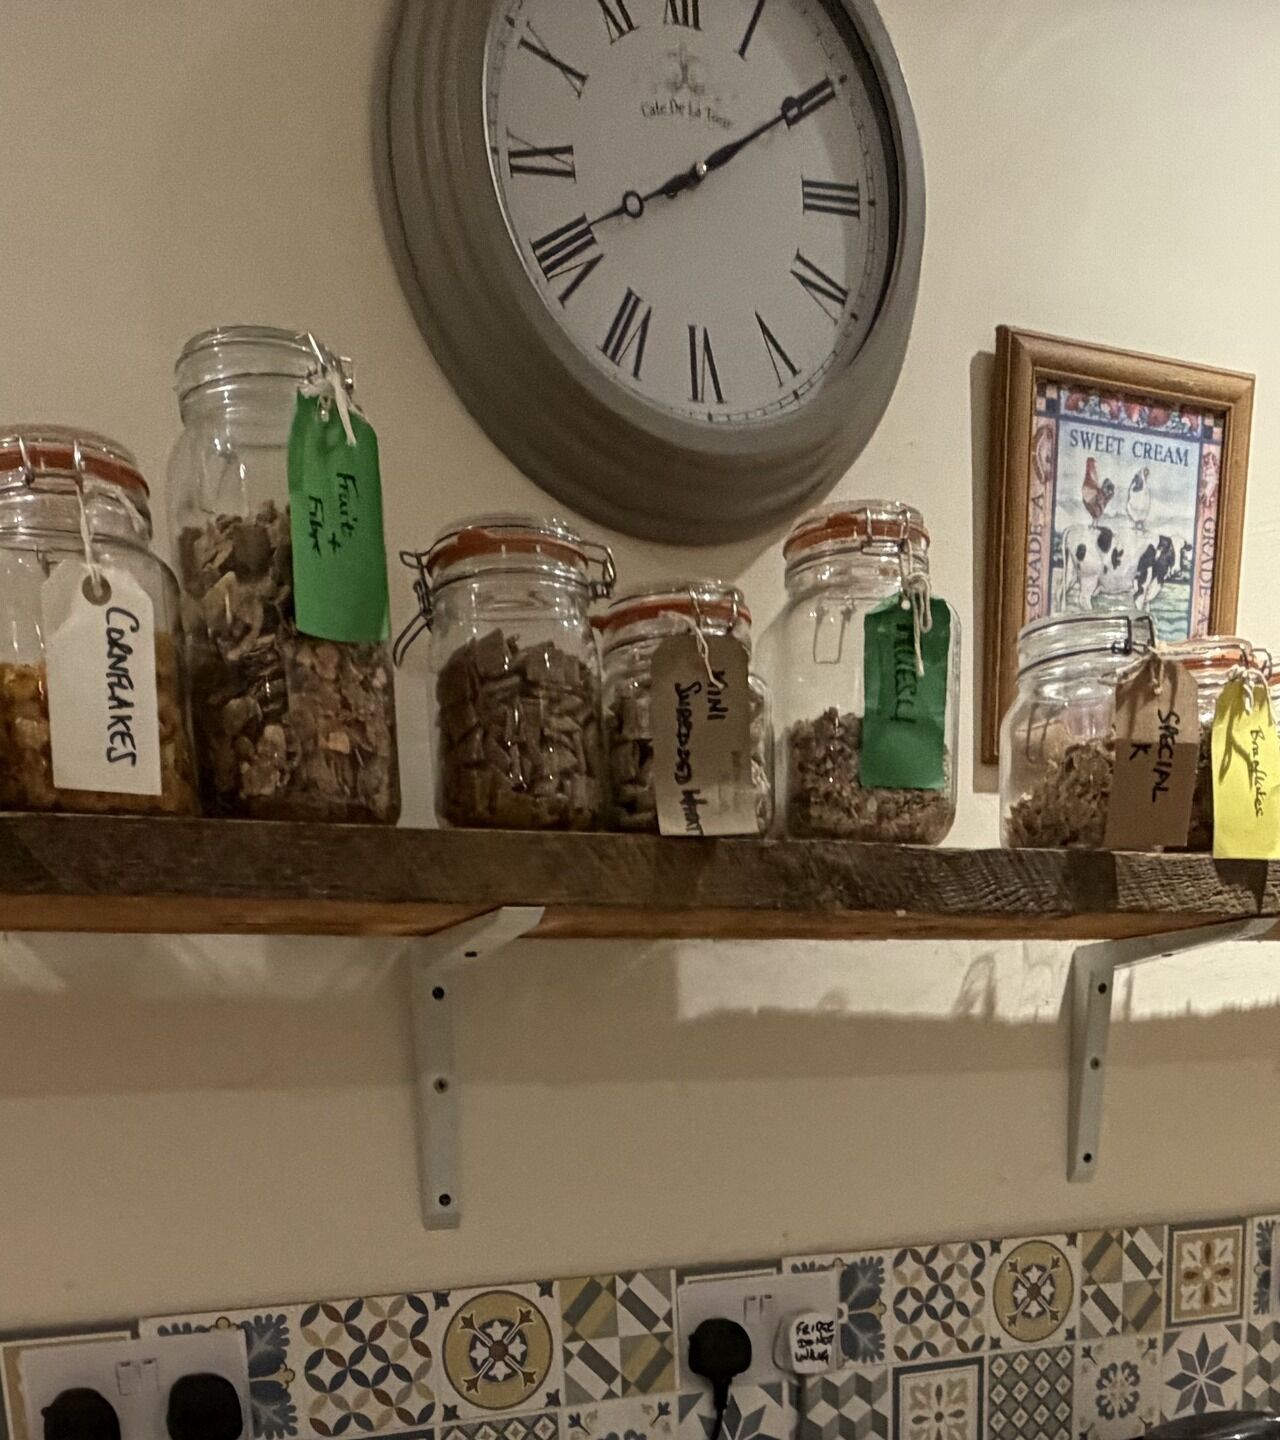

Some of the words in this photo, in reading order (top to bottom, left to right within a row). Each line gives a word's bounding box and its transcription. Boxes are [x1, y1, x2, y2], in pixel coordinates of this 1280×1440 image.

[518, 21, 588, 99] X
[1070, 429, 1125, 456] SWEET
[1131, 440, 1191, 468] CREAM
[1026, 523, 1044, 607] GRADE
[1200, 517, 1216, 600] GRADE
[106, 606, 140, 768] CORNFLAKES
[1129, 742, 1151, 761] K
[1152, 709, 1181, 803] SPECIAL
